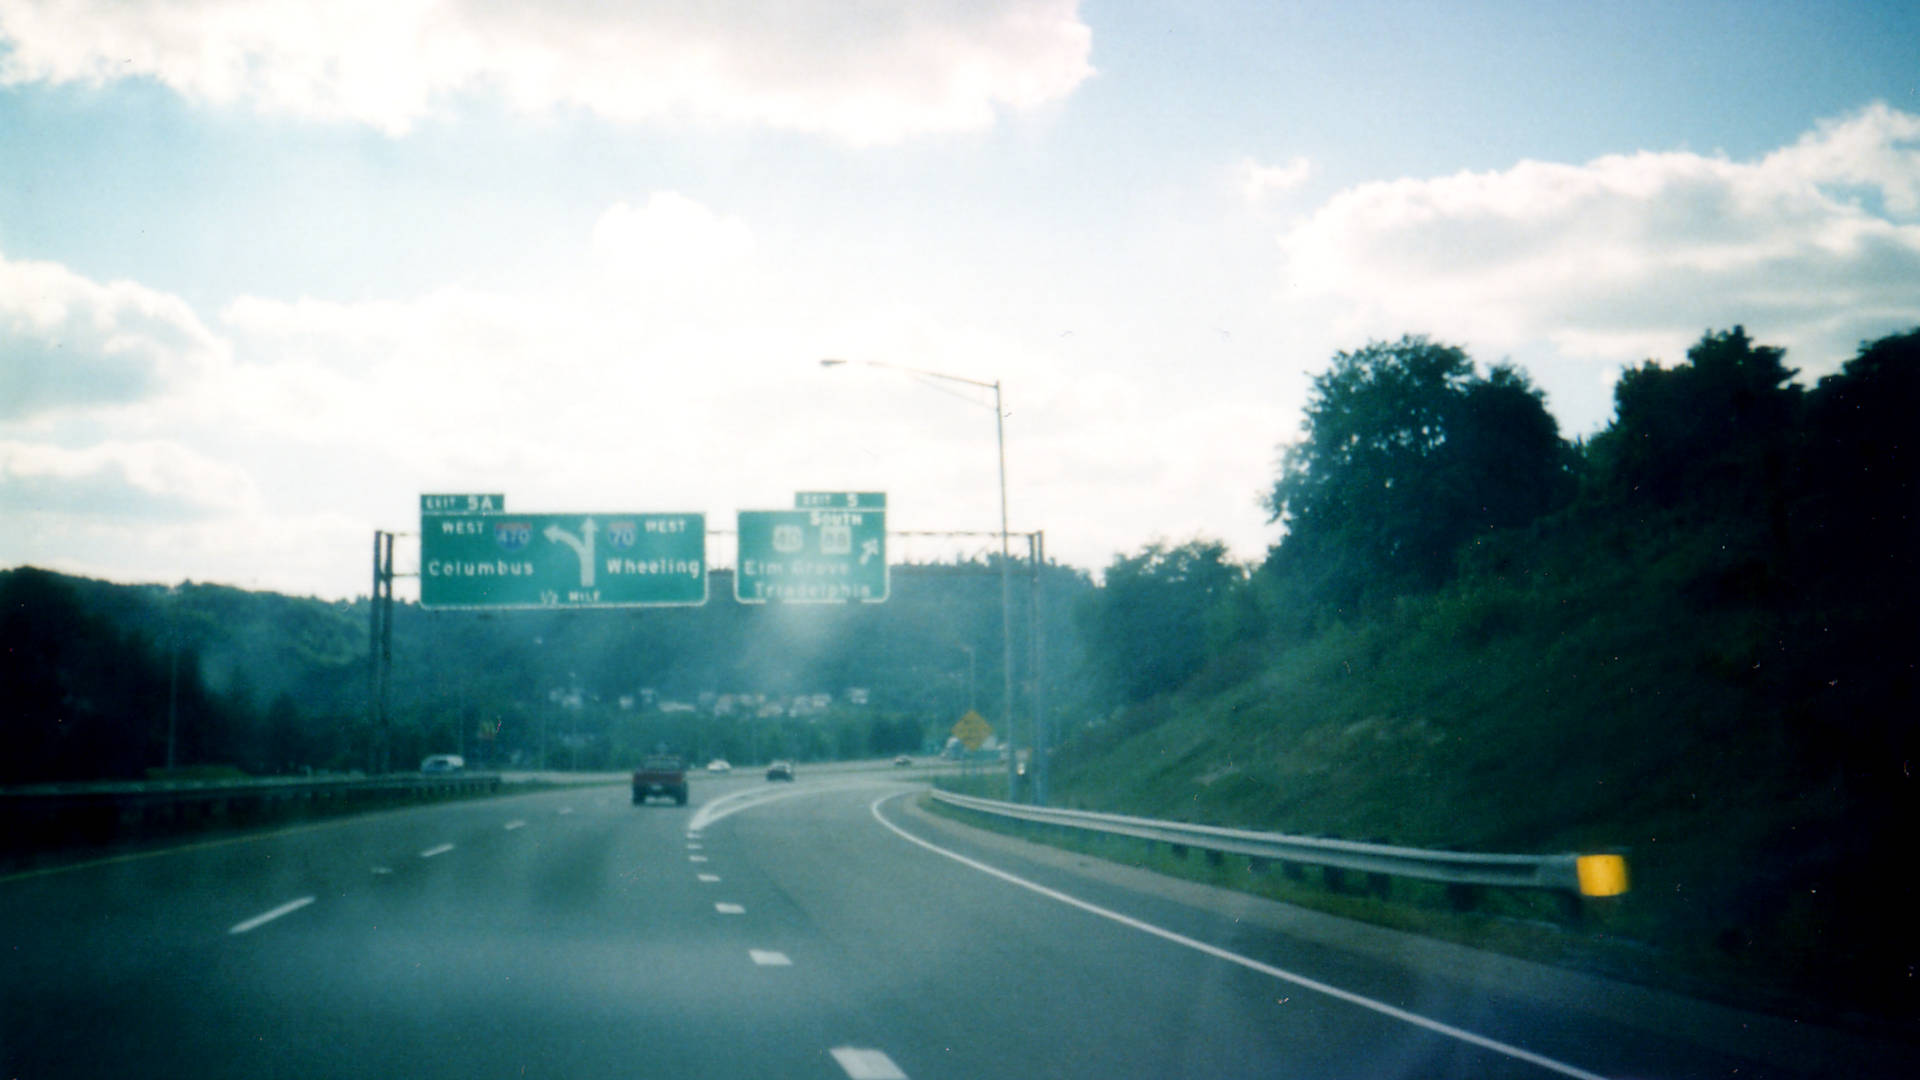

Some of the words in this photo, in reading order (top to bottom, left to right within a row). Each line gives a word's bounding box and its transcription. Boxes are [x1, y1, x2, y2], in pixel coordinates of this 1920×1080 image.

[467, 495, 494, 511] 5A
[442, 521, 484, 535] WEST
[645, 520, 687, 534] WEST
[613, 528, 635, 547] 70
[428, 559, 534, 576] Columbus
[606, 558, 700, 579] Wheeling
[744, 560, 783, 576] Elm
[791, 560, 849, 576] Grove
[568, 591, 600, 602] MILE
[755, 582, 871, 600] Triadelphia
